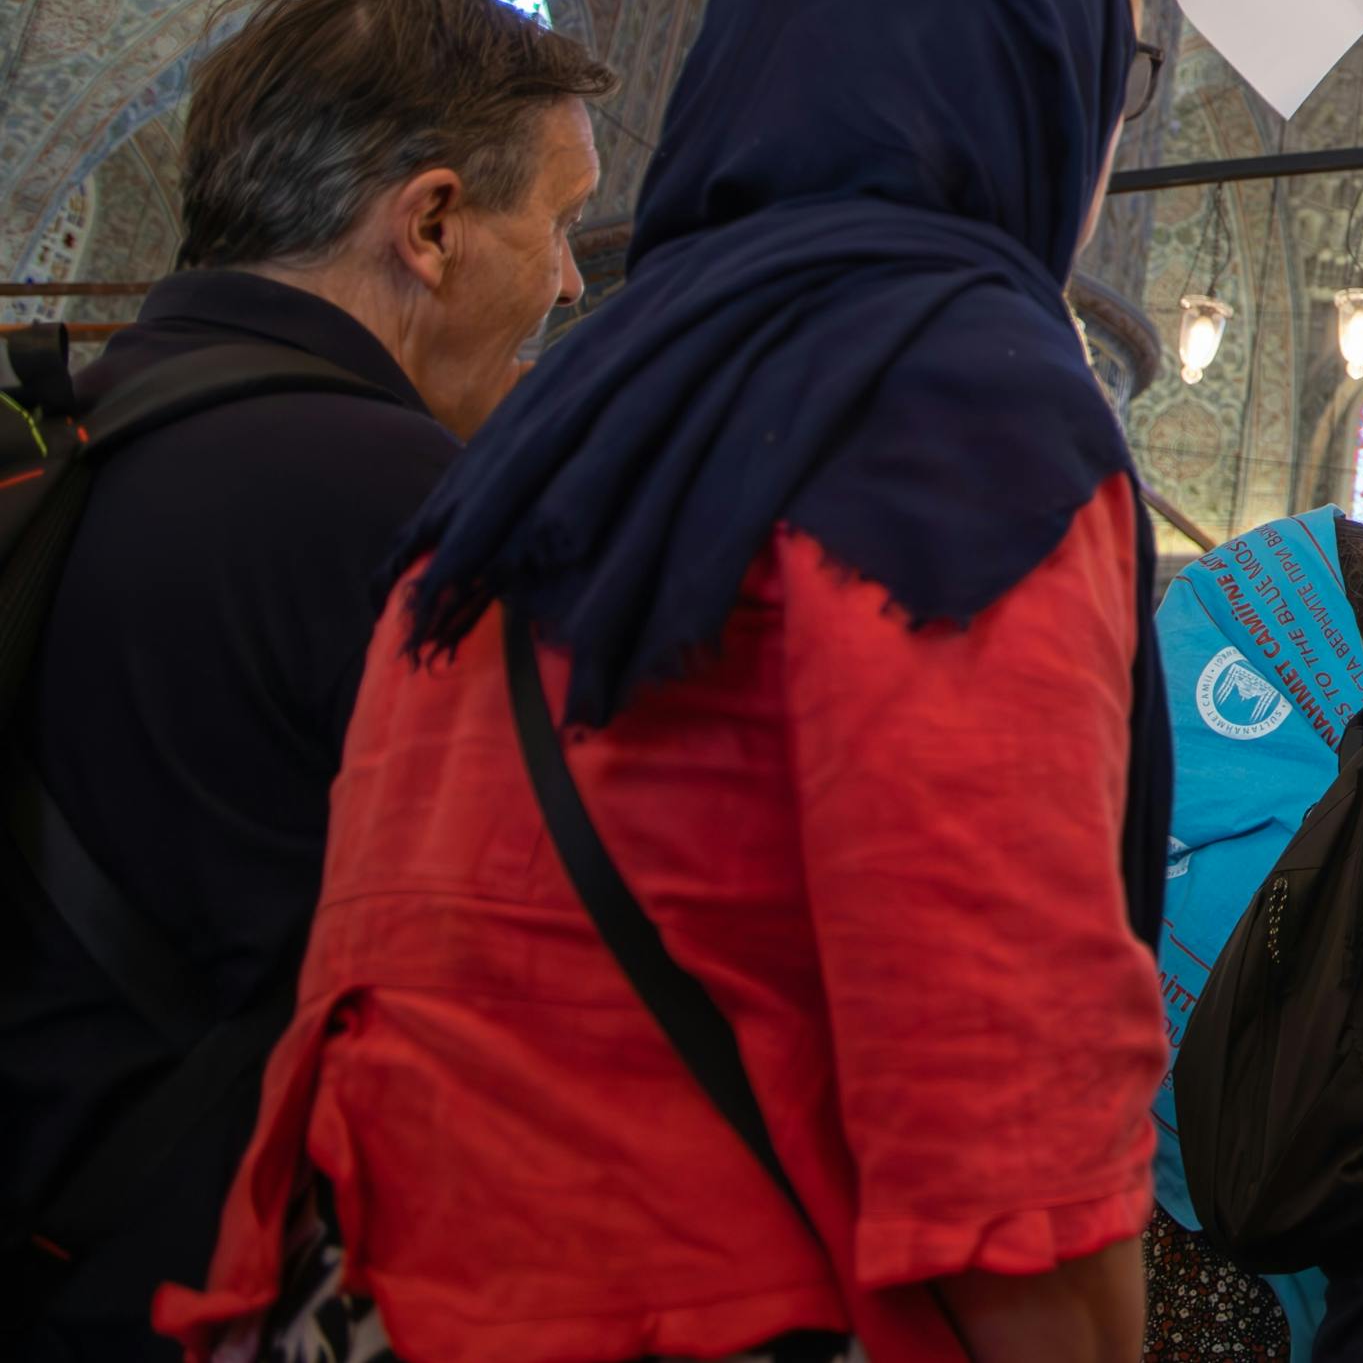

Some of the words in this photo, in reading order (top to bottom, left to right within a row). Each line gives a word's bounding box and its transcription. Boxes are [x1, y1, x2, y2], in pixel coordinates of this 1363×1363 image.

[1224, 539, 1264, 580] MOS
[1274, 546, 1306, 583] ПРИ
[1255, 575, 1295, 626] BLUE
[1296, 583, 1350, 658] ВЕРНИТЕ
[1288, 628, 1319, 669] THE
[1274, 660, 1341, 754] NAHMET
[1315, 672, 1340, 702] TO
